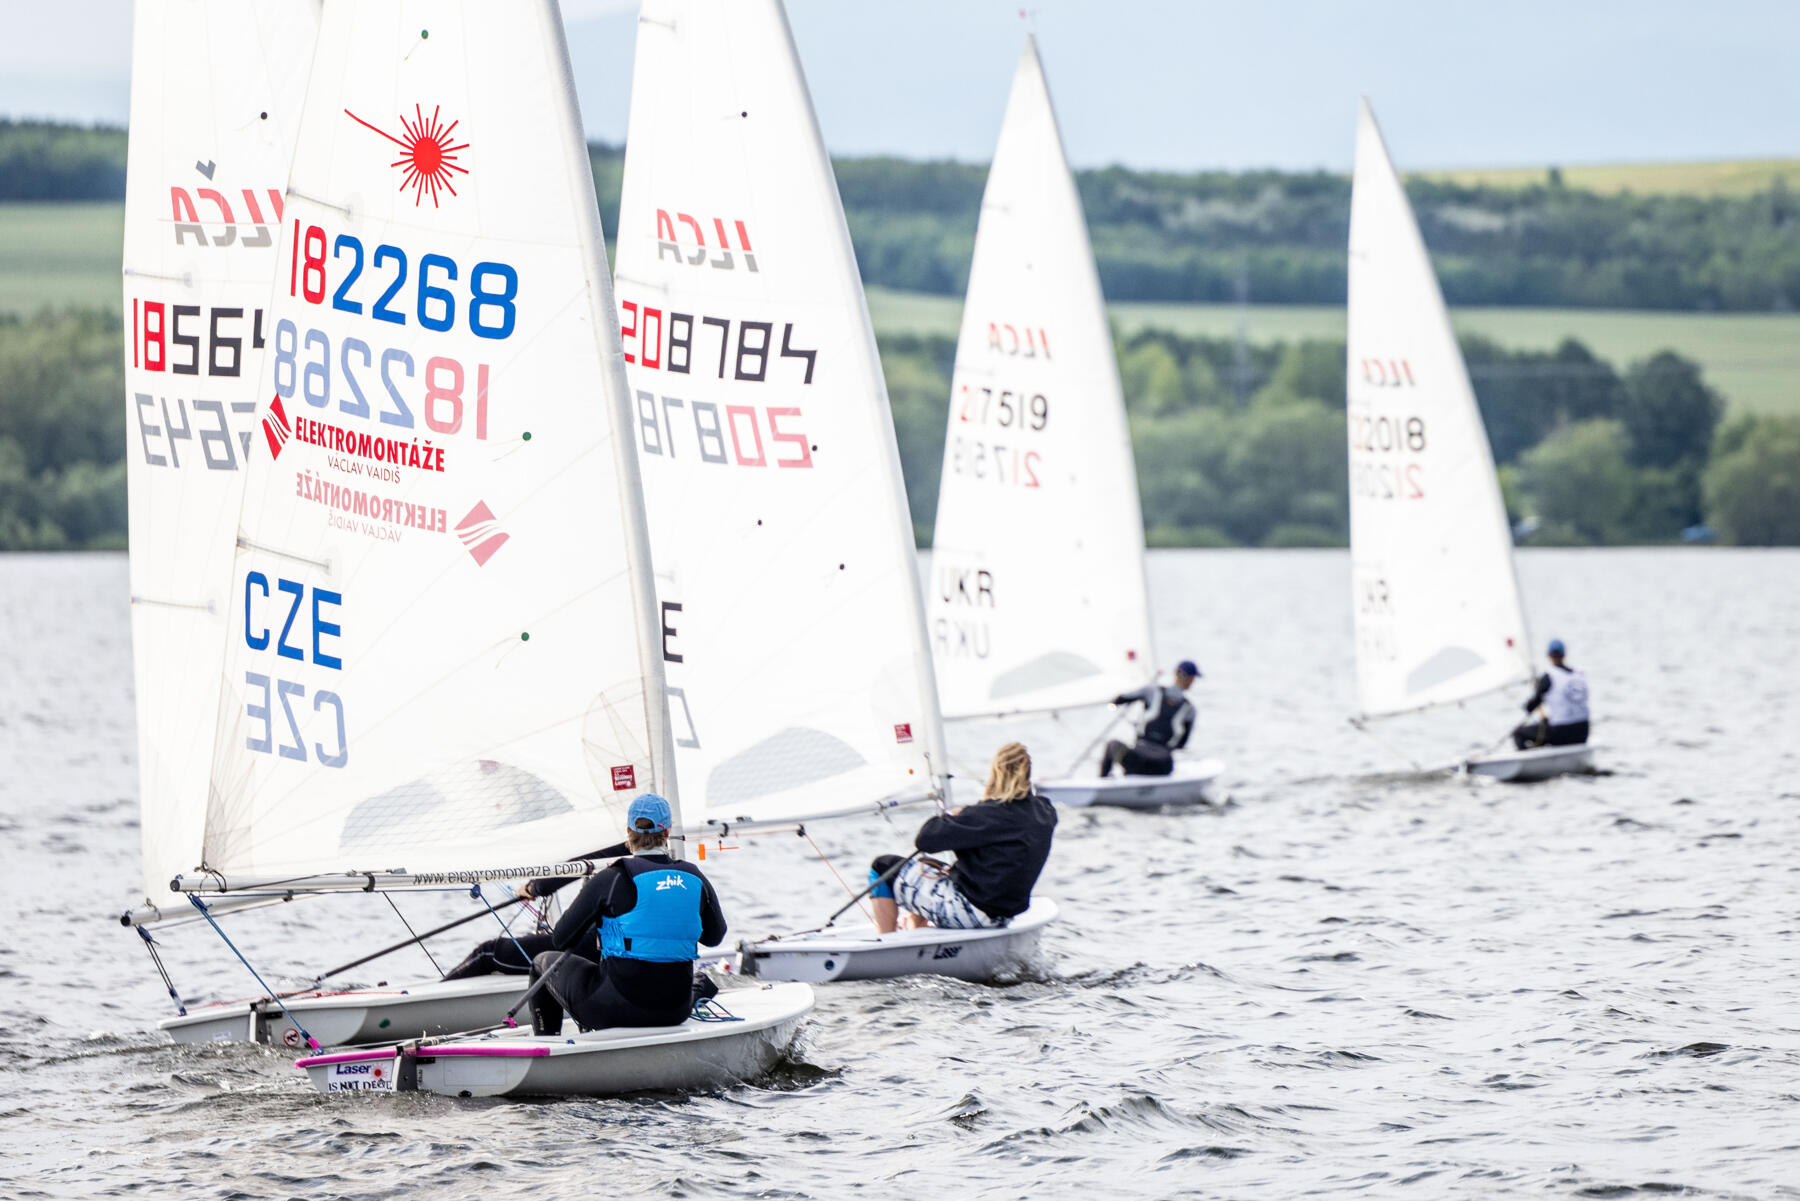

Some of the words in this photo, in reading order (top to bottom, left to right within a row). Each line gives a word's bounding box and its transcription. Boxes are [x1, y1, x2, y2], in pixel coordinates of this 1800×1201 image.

[291, 218, 518, 340] 182268
[621, 300, 818, 384] 208784
[296, 416, 445, 472] ELEKTROMONTÁŽE
[328, 452, 363, 475] VÁCLAV
[366, 464, 401, 484] VAIDIŠ
[245, 570, 342, 670] CZE
[656, 874, 687, 890] zhik
[336, 1063, 372, 1075] Laser
